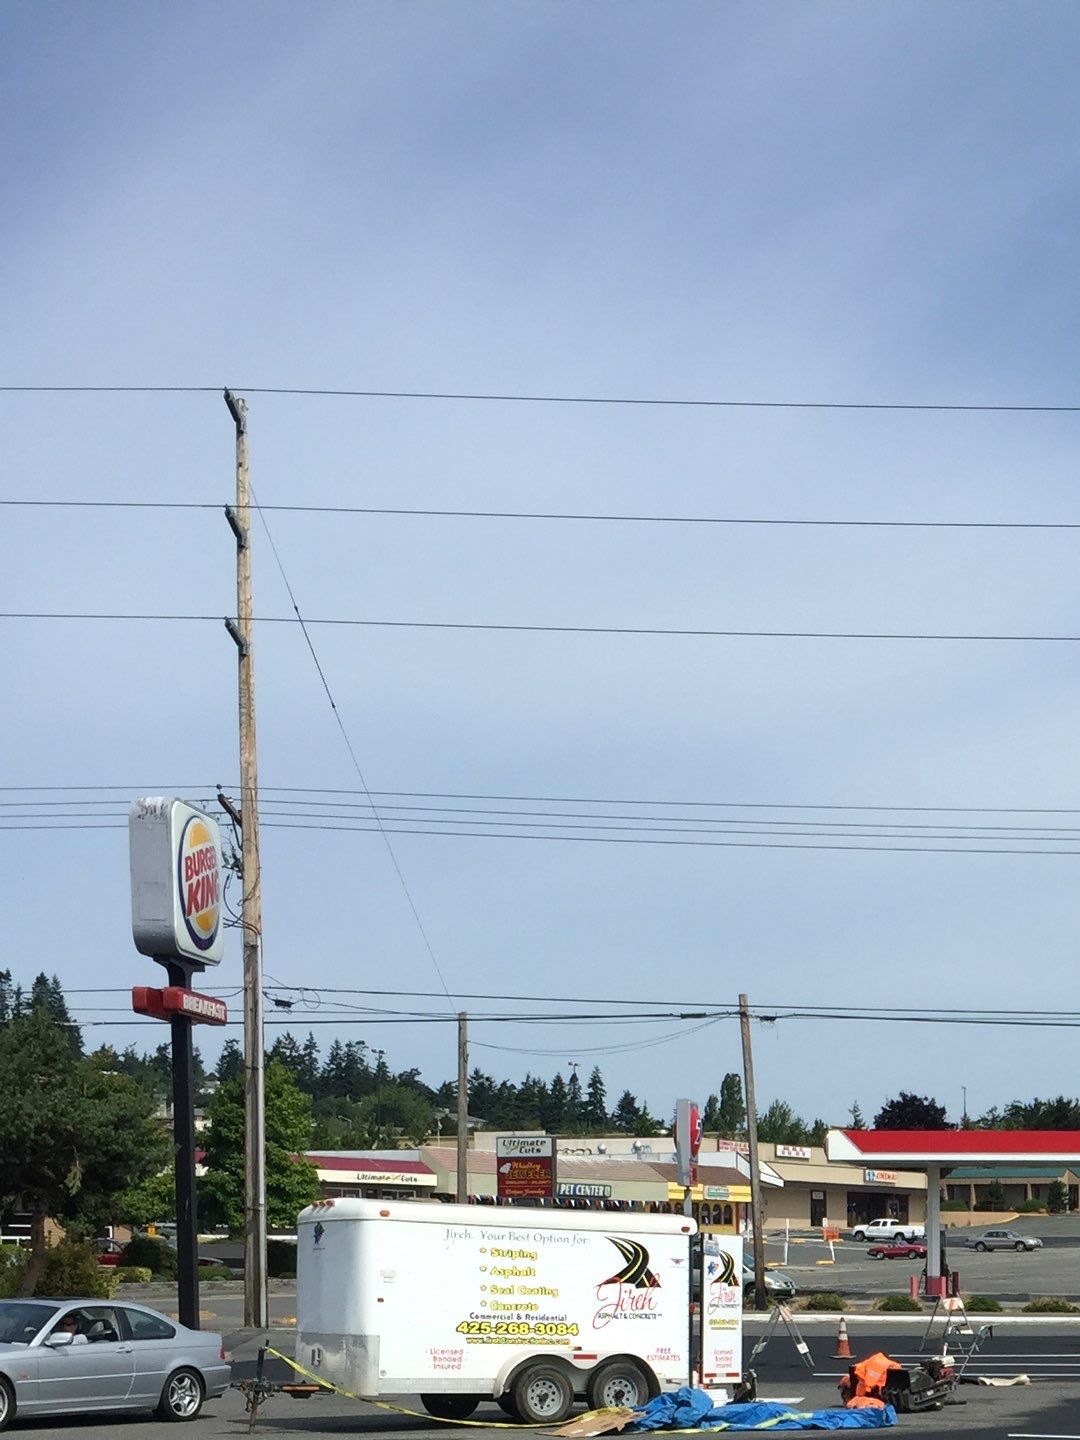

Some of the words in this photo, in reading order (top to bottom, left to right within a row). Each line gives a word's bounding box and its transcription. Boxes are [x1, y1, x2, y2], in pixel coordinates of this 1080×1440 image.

[185, 846, 217, 882] BURGE
[186, 870, 219, 917] KING
[502, 1139, 546, 1147] Ultimate
[519, 1146, 542, 1154] Cuts
[560, 1184, 576, 1195] PET
[576, 1184, 605, 1196] CENTER
[480, 1230, 506, 1241] Your
[508, 1231, 530, 1241] Best
[533, 1232, 570, 1245] Option
[571, 1233, 588, 1247] for
[490, 1247, 538, 1260] Striping
[490, 1266, 536, 1278] Asphalt
[490, 1285, 515, 1295] Seal
[518, 1285, 559, 1298] Coating
[490, 1300, 539, 1311] Concrete
[469, 1312, 513, 1320] Commercial
[525, 1313, 567, 1321] Residential
[456, 1321, 579, 1336] 425-268-3084
